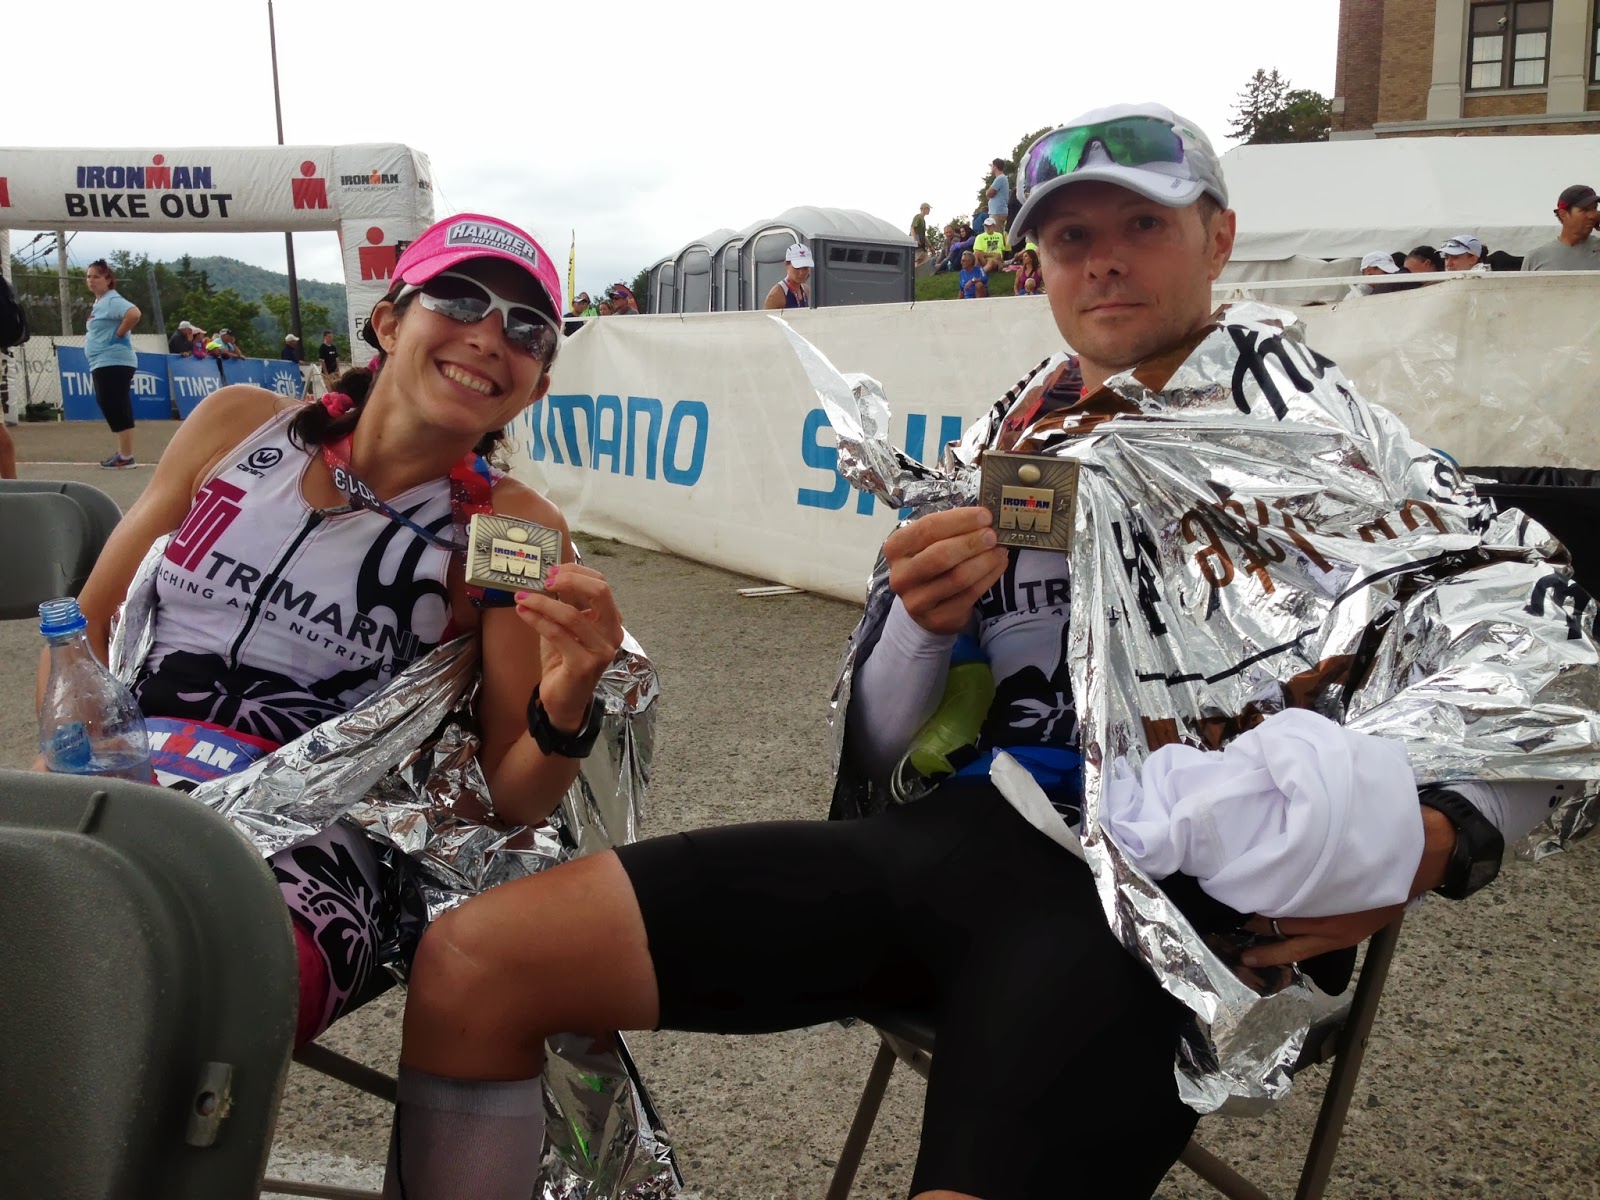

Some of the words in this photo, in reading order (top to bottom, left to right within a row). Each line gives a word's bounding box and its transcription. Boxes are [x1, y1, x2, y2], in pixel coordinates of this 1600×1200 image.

[77, 154, 212, 189] IRONMAN
[340, 169, 400, 185] IRONMAN
[65, 193, 150, 218] BIKE
[160, 193, 233, 218] OUT
[452, 224, 536, 258] HAMMER
[471, 237, 523, 256] NUTRITION
[62, 371, 95, 396] TIM
[174, 376, 222, 397] TIMEX
[276, 378, 298, 399] GU
[1002, 495, 1050, 509] IRONMAN
[1010, 533, 1037, 542] 2013
[494, 547, 538, 561] IRONMAN
[502, 574, 528, 585] 2013
[158, 567, 215, 600] ACHING
[289, 621, 395, 673] NUTRITIO
